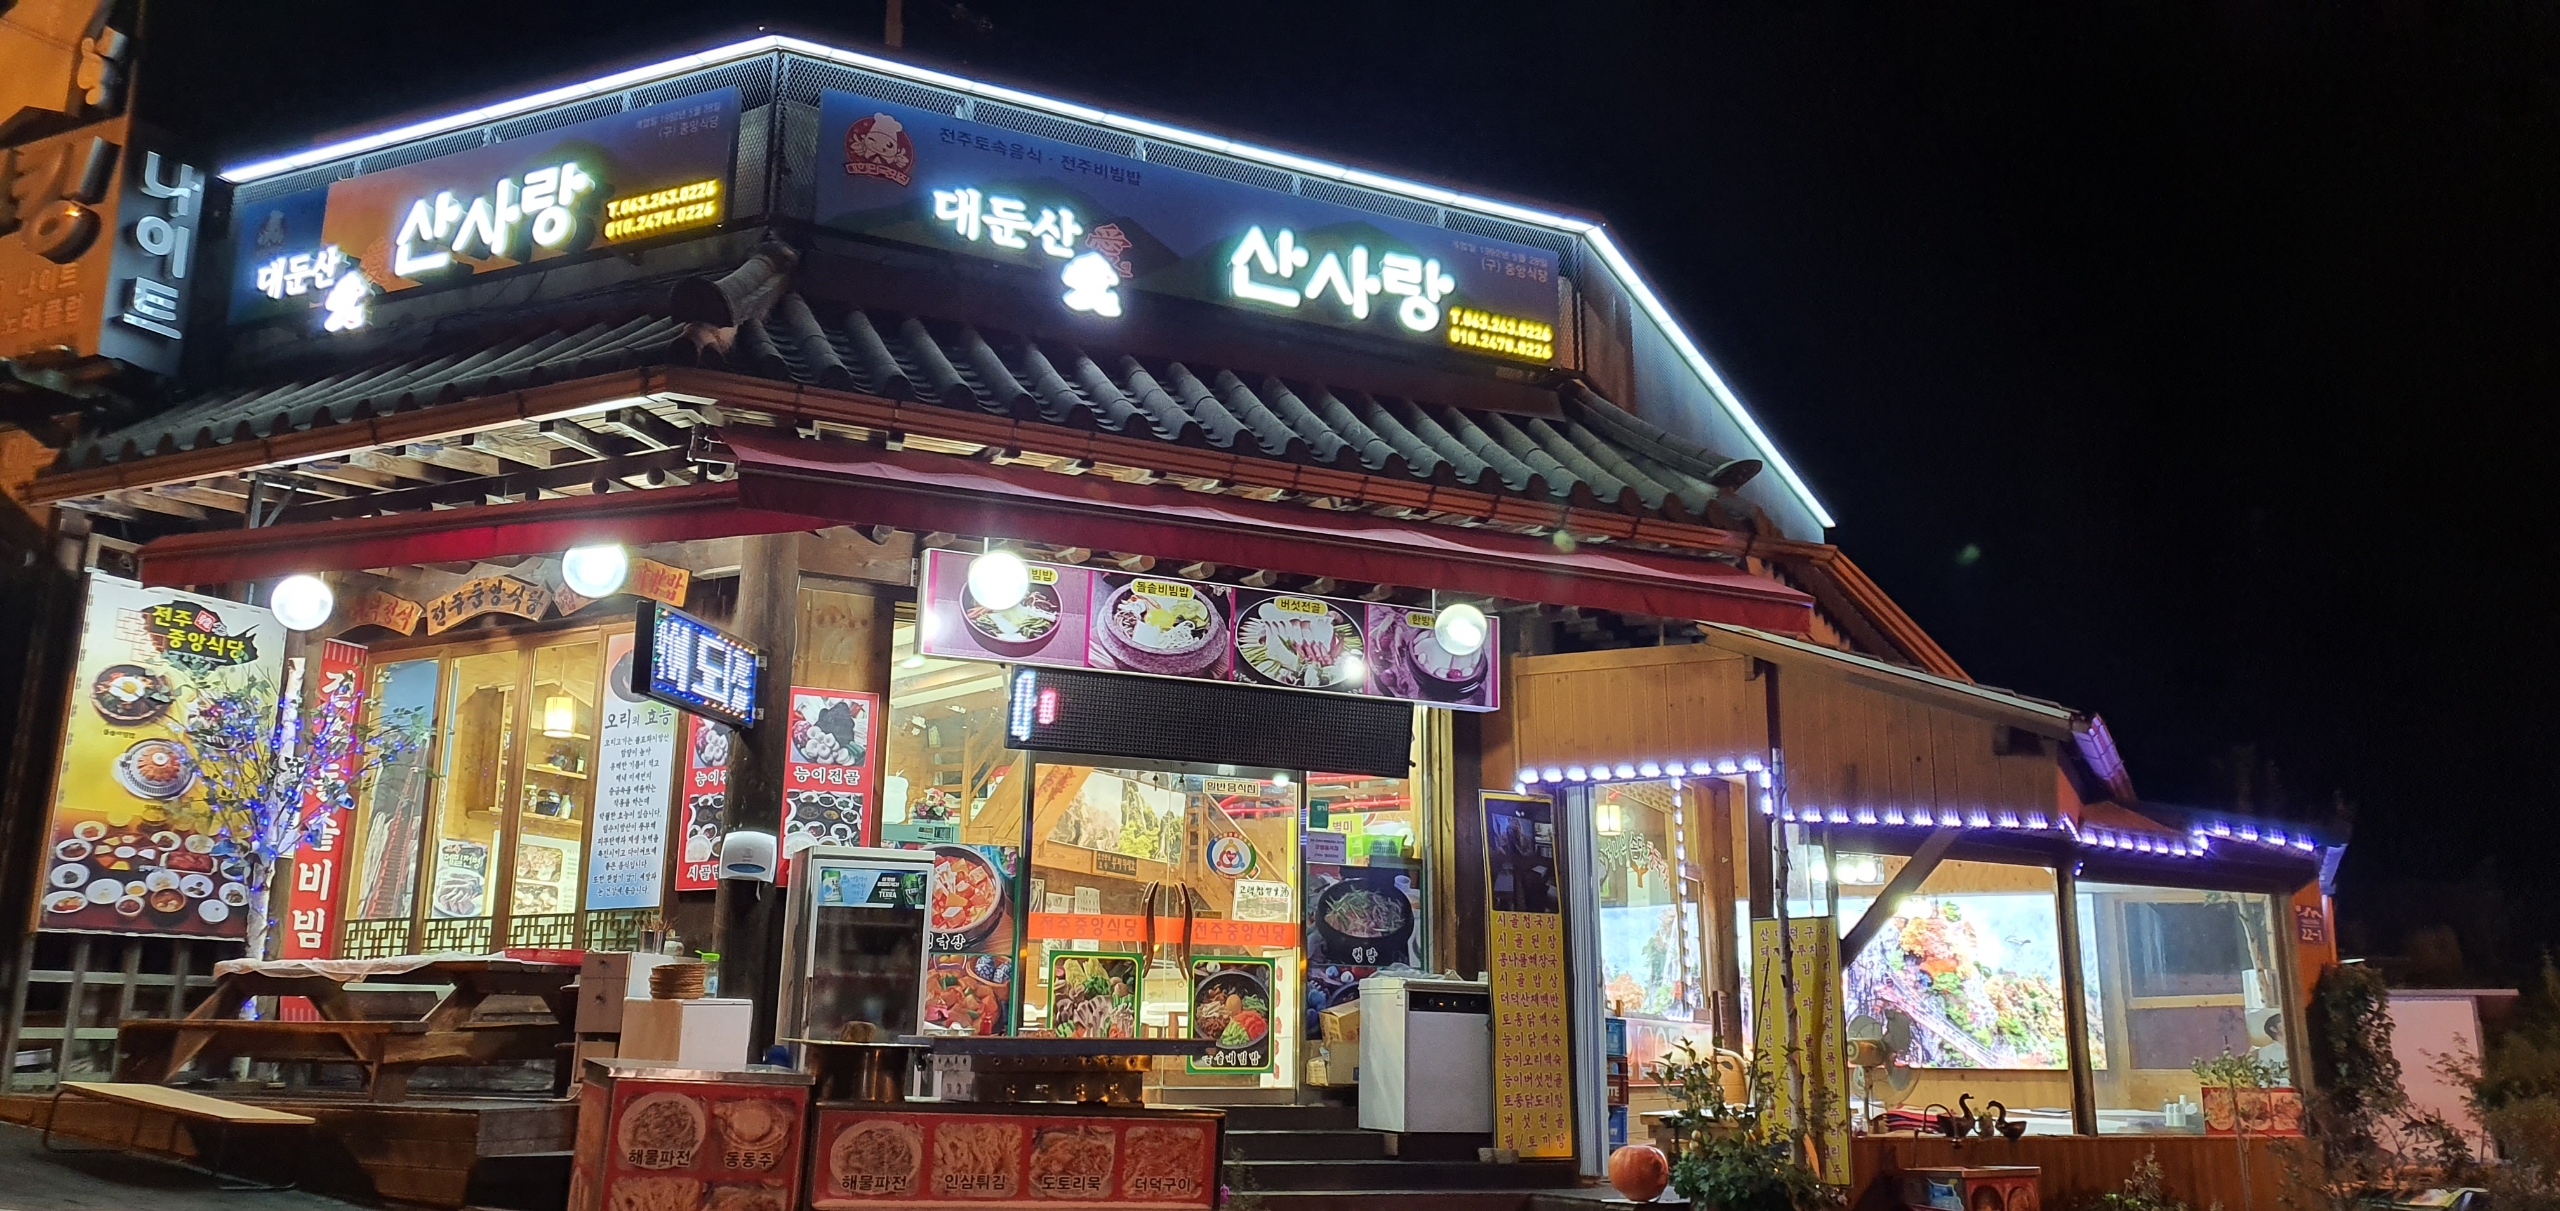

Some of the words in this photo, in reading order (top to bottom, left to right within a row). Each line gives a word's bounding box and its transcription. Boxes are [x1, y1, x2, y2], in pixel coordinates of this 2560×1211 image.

[658, 125, 677, 139] (구)
[679, 115, 719, 136] 중앙식당
[939, 126, 1043, 164] 전주토속음식
[1060, 154, 1142, 187] 전주비빔밥
[606, 178, 719, 219] T.063.263.0226
[394, 161, 597, 278] 산사랑
[604, 200, 716, 241] 010.2478.0226
[932, 187, 1084, 259] 대둔산
[123, 150, 203, 341] 나이트
[256, 245, 345, 300] 대둔산
[1230, 224, 1456, 333] 산사랑
[1481, 257, 1501, 273] (구)
[1505, 262, 1549, 283] 중앙식당
[1449, 305, 1554, 342] T.063.263.0226
[1449, 325, 1554, 360] 010.2478.0226
[1030, 567, 1055, 583] 빔밥
[1136, 580, 1191, 598] 돌솥비빔밥
[430, 579, 546, 628] 전주중앙식당
[1279, 598, 1322, 614] 버섯전골
[152, 605, 193, 628] 전주
[1411, 613, 1436, 628] 한방
[167, 628, 245, 660] 중앙식당
[605, 708, 640, 730] 오리의
[645, 706, 672, 727] 효능
[604, 735, 633, 747] 오리고기는
[635, 733, 669, 745] 불포화지방산
[629, 771, 652, 782] 미세먼지
[793, 766, 861, 785] 능이전골
[1206, 781, 1256, 794] 일반음식점
[617, 809, 635, 820] 효능이
[637, 807, 661, 819] 있습니다.
[1332, 820, 1353, 833] 별미
[628, 846, 657, 857] 다이어트에
[443, 853, 482, 869] 메밀전병
[626, 872, 637, 883] 감기
[1039, 915, 1138, 938] 전주중앙식당
[1496, 912, 1556, 930] 시골청국장
[1193, 921, 1286, 943] 전주중앙식당
[1496, 931, 1557, 949] 시골된장
[1497, 952, 1558, 969] 콩나물해장국
[1498, 971, 1558, 989] 시골밥상
[1500, 991, 1560, 1009] 더덕산채백반
[1763, 996, 1833, 1011] 해파전
[1501, 1011, 1561, 1029] 토종닭백숙
[1763, 1015, 1833, 1030] 김전
[1501, 1031, 1562, 1048] 능이닭백숙
[1501, 1051, 1562, 1068] 능이오리백숙
[1502, 1071, 1564, 1089] 능이버섯전골
[1503, 1091, 1565, 1109] 토종닭도리탕
[1503, 1112, 1565, 1130] 버섯전골
[628, 1148, 692, 1167] 해물파전
[724, 1151, 774, 1169] 동동주
[841, 1173, 908, 1192] 해물파전
[943, 1173, 1007, 1191] 인삼튀김
[1040, 1175, 1101, 1192] 도토리묵
[1134, 1177, 1192, 1193] 더덕구이
